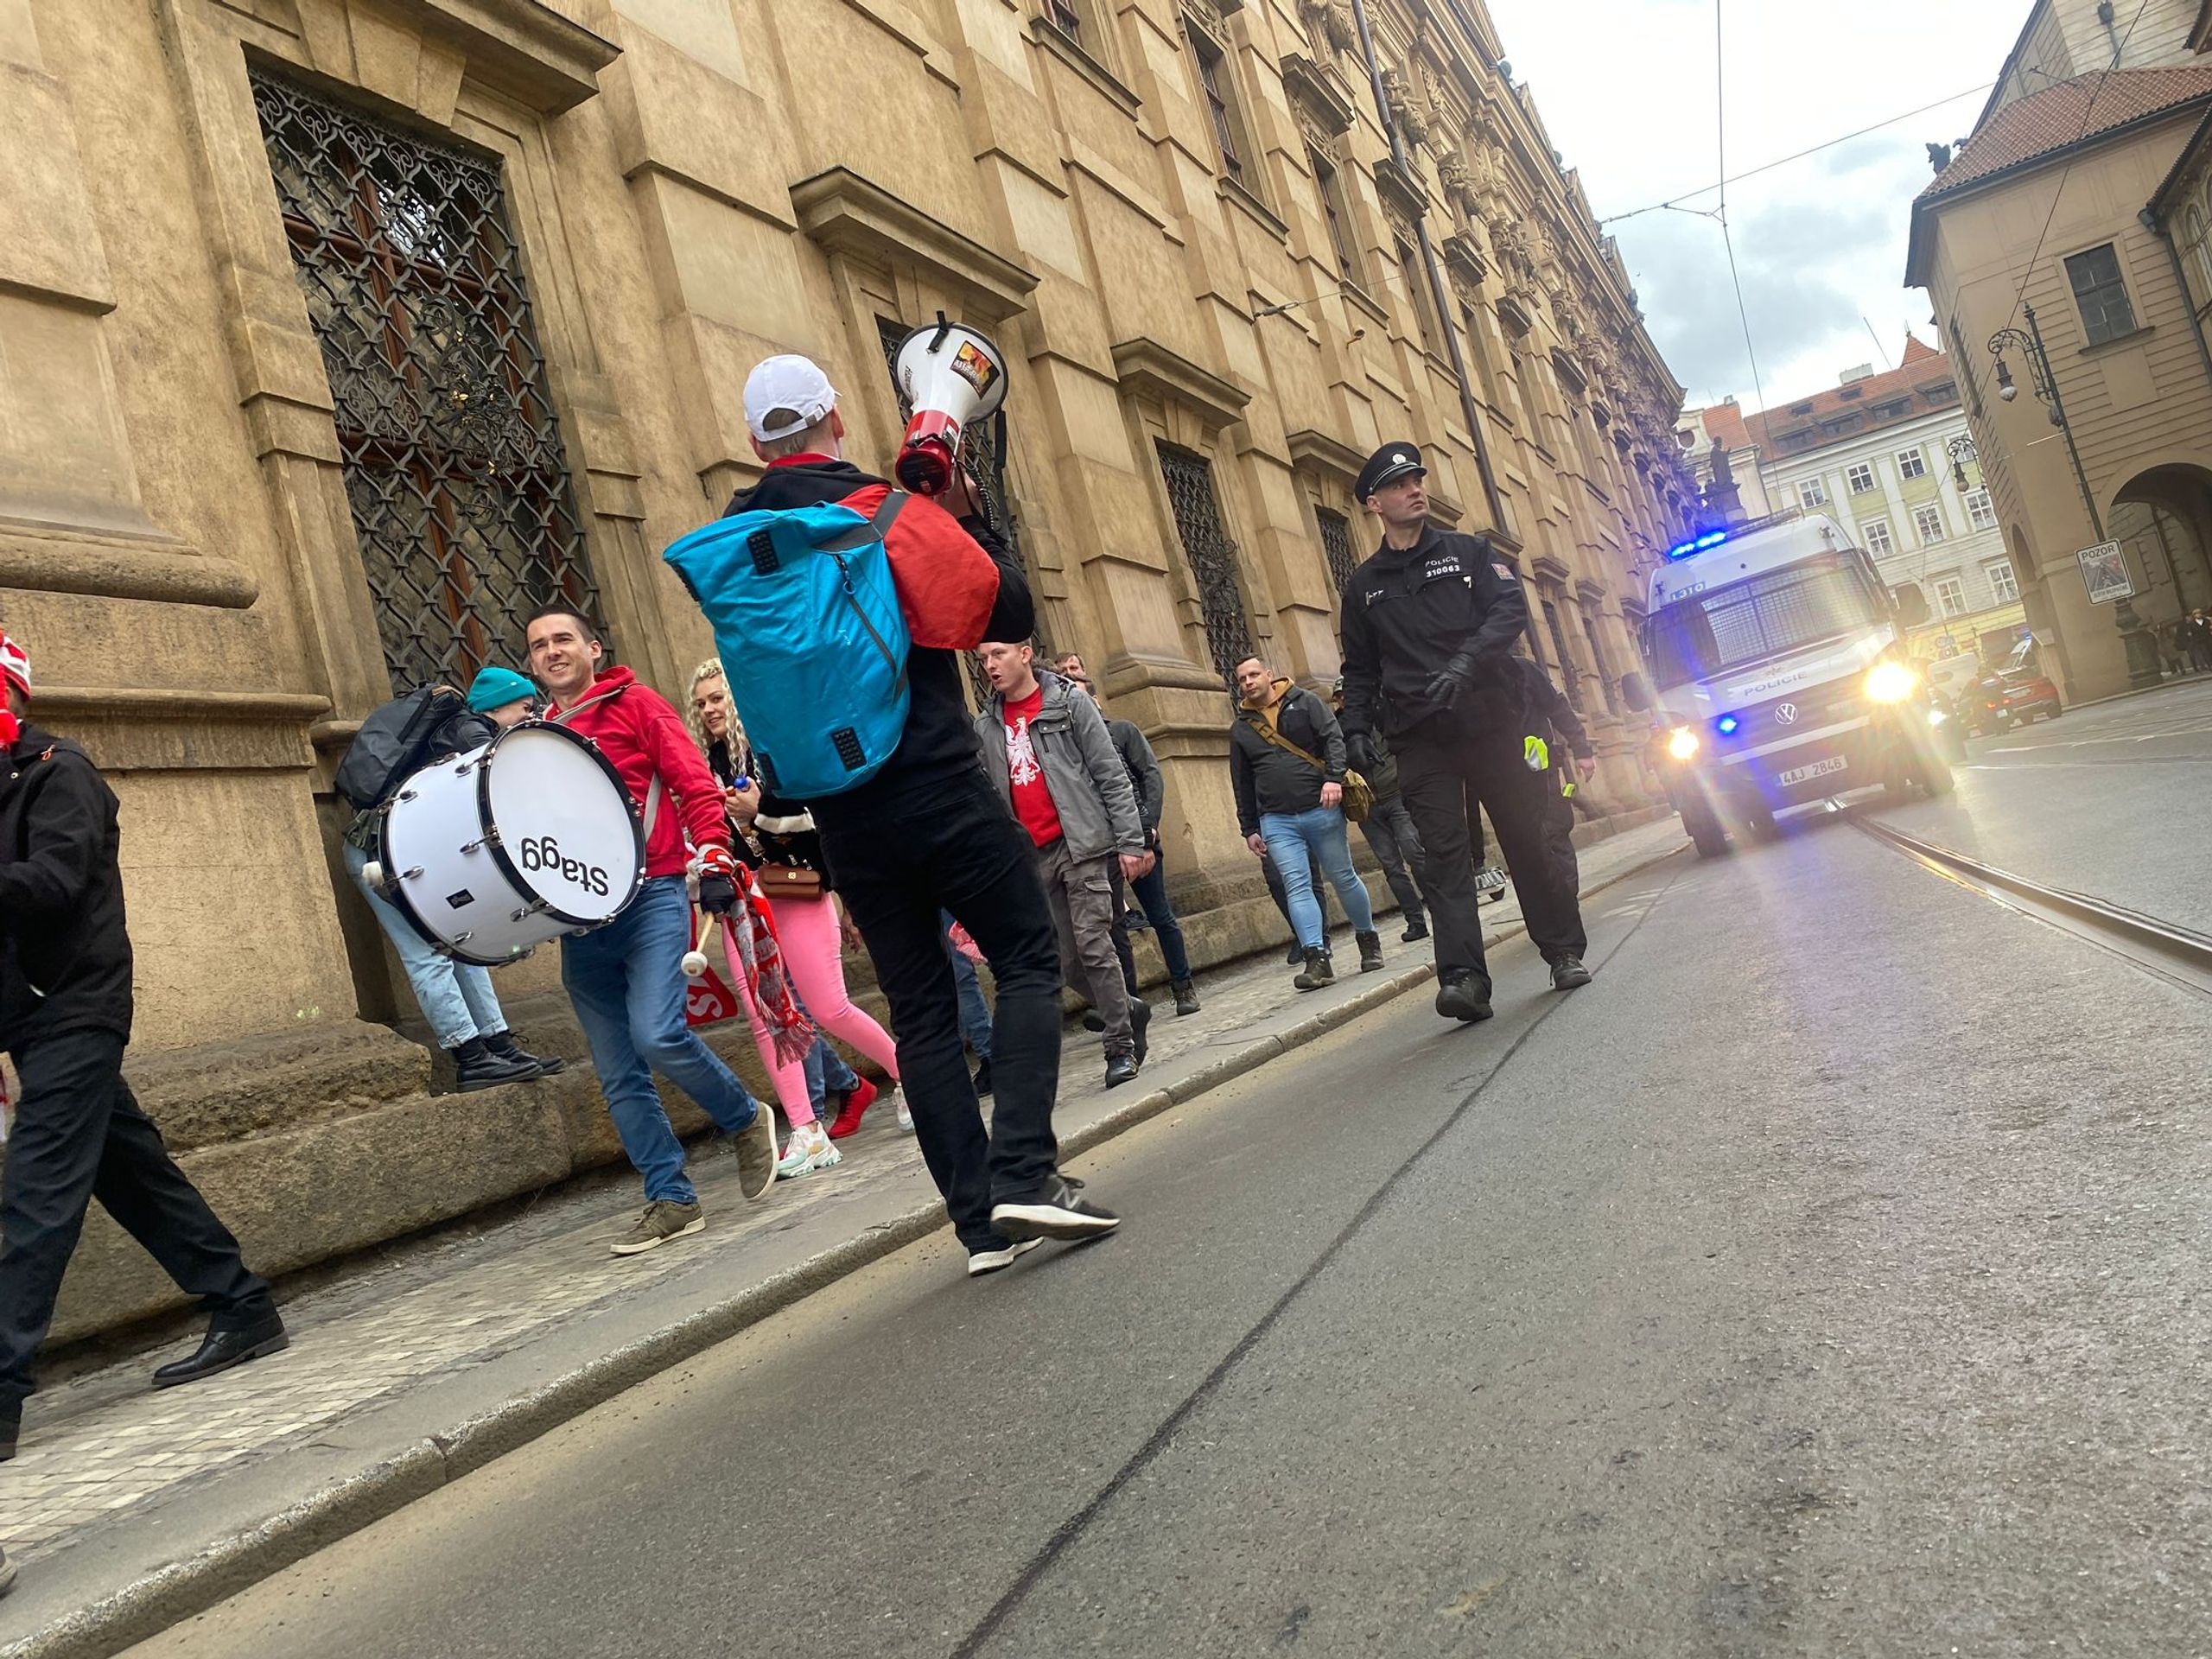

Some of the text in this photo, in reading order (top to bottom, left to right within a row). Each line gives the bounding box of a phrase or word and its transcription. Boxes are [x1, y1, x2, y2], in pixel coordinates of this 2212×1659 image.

[2082, 545, 2115, 560] POZOR
[1745, 671, 1808, 696] POLICIE
[1783, 758, 1842, 784] 4AJ 2846
[521, 836, 609, 896] Stagg
